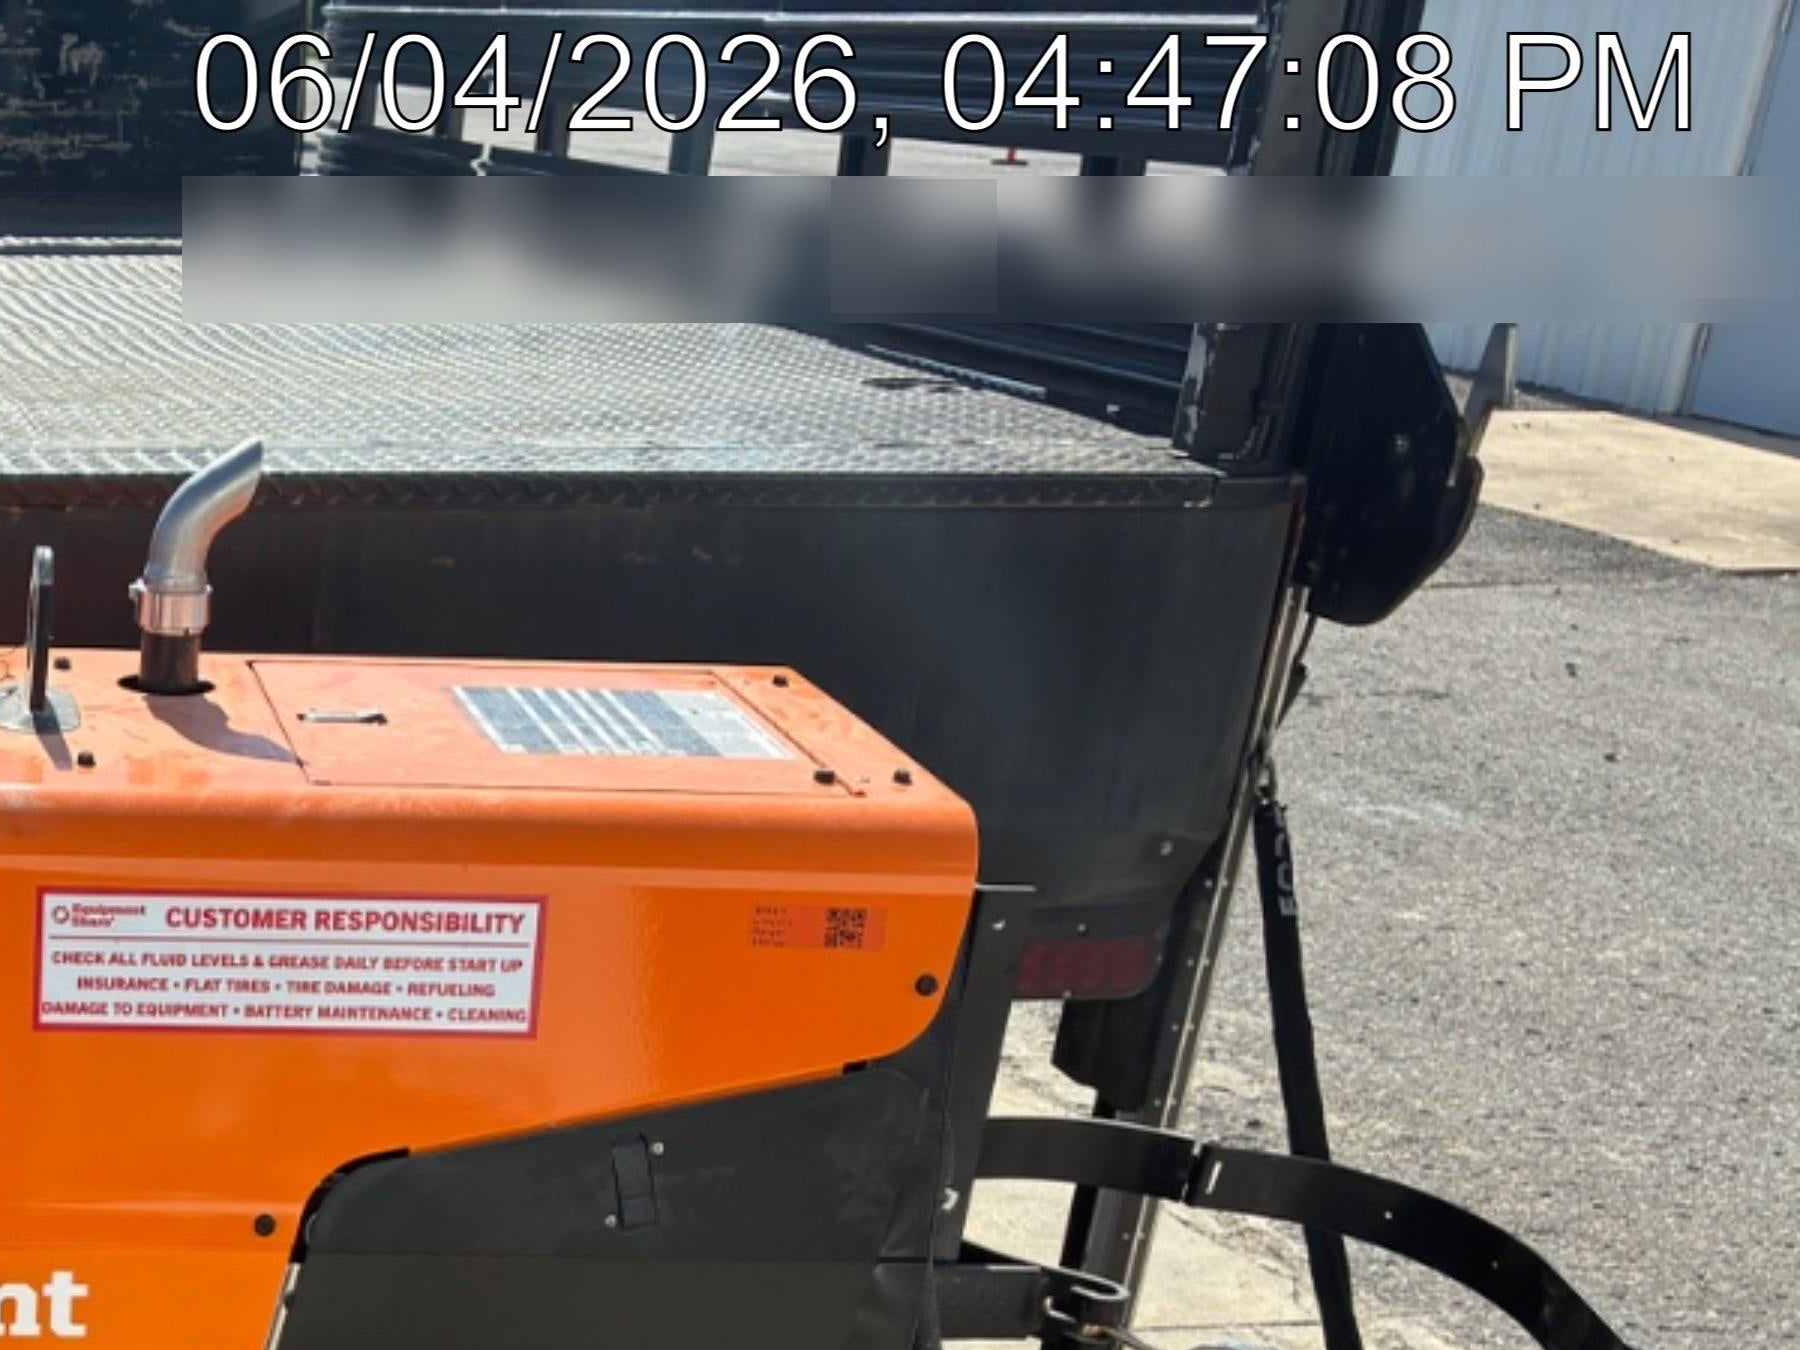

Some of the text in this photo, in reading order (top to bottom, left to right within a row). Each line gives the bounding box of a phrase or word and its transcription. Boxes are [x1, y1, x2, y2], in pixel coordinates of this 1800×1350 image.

[166, 906, 525, 934] CUSTOMER RESPONSIBILITY
[52, 951, 523, 973] CHECK ALL FLUID LEVELS & GREASE DAILY BEFORE START UP
[77, 976, 496, 998] INSURANCE FLAT TIRES TIRE DAMAGE REFUELING
[41, 1001, 526, 1024] DAMAGE TO EQUIPMENT BATTERY MAINTENANCE CLEANING
